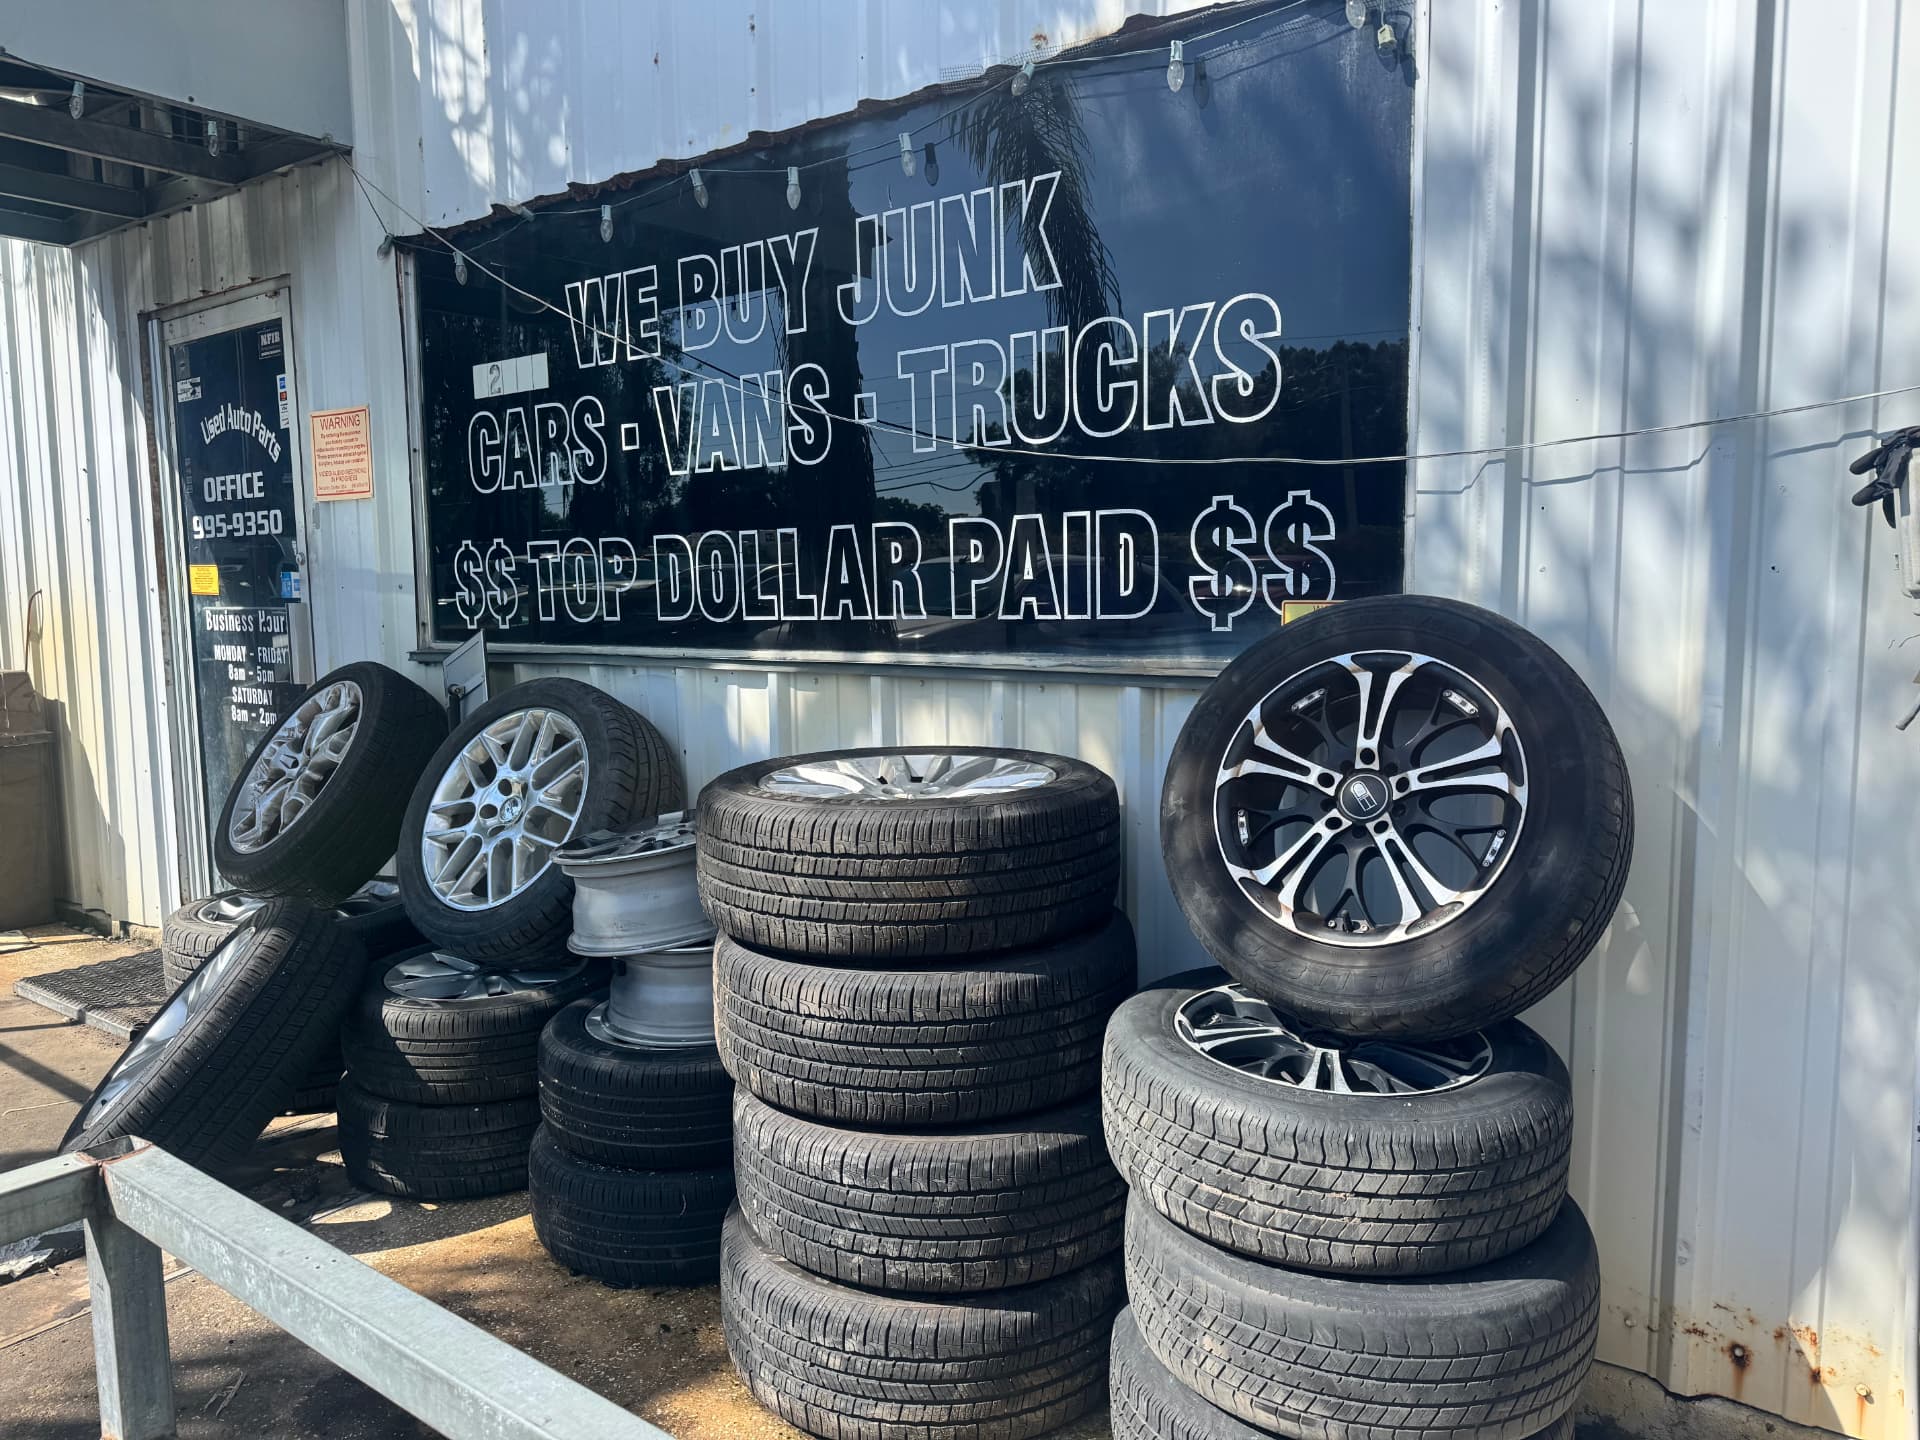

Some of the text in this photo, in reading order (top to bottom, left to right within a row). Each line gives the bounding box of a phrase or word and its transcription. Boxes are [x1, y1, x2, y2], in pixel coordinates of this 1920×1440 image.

[565, 171, 1062, 368] WE BUY JUNK
[468, 292, 1282, 493] CARS VANS TRUCKS
[489, 364, 502, 395] 2
[200, 402, 281, 463] Used Auto Parts
[320, 414, 361, 431] WARNING
[203, 471, 265, 503] OFFICE
[192, 509, 283, 539] 995-9350
[454, 490, 1336, 632] $$ TOP DOLLAR PAID $$
[205, 610, 287, 633] Business Hour
[214, 644, 247, 662] MONDAY
[257, 646, 287, 665] FRIDAY
[228, 664, 246, 680] 8am
[256, 666, 275, 685] 5pm
[232, 686, 273, 706] SATURDAY
[231, 705, 249, 722] 8am
[259, 708, 277, 727] 2pm
